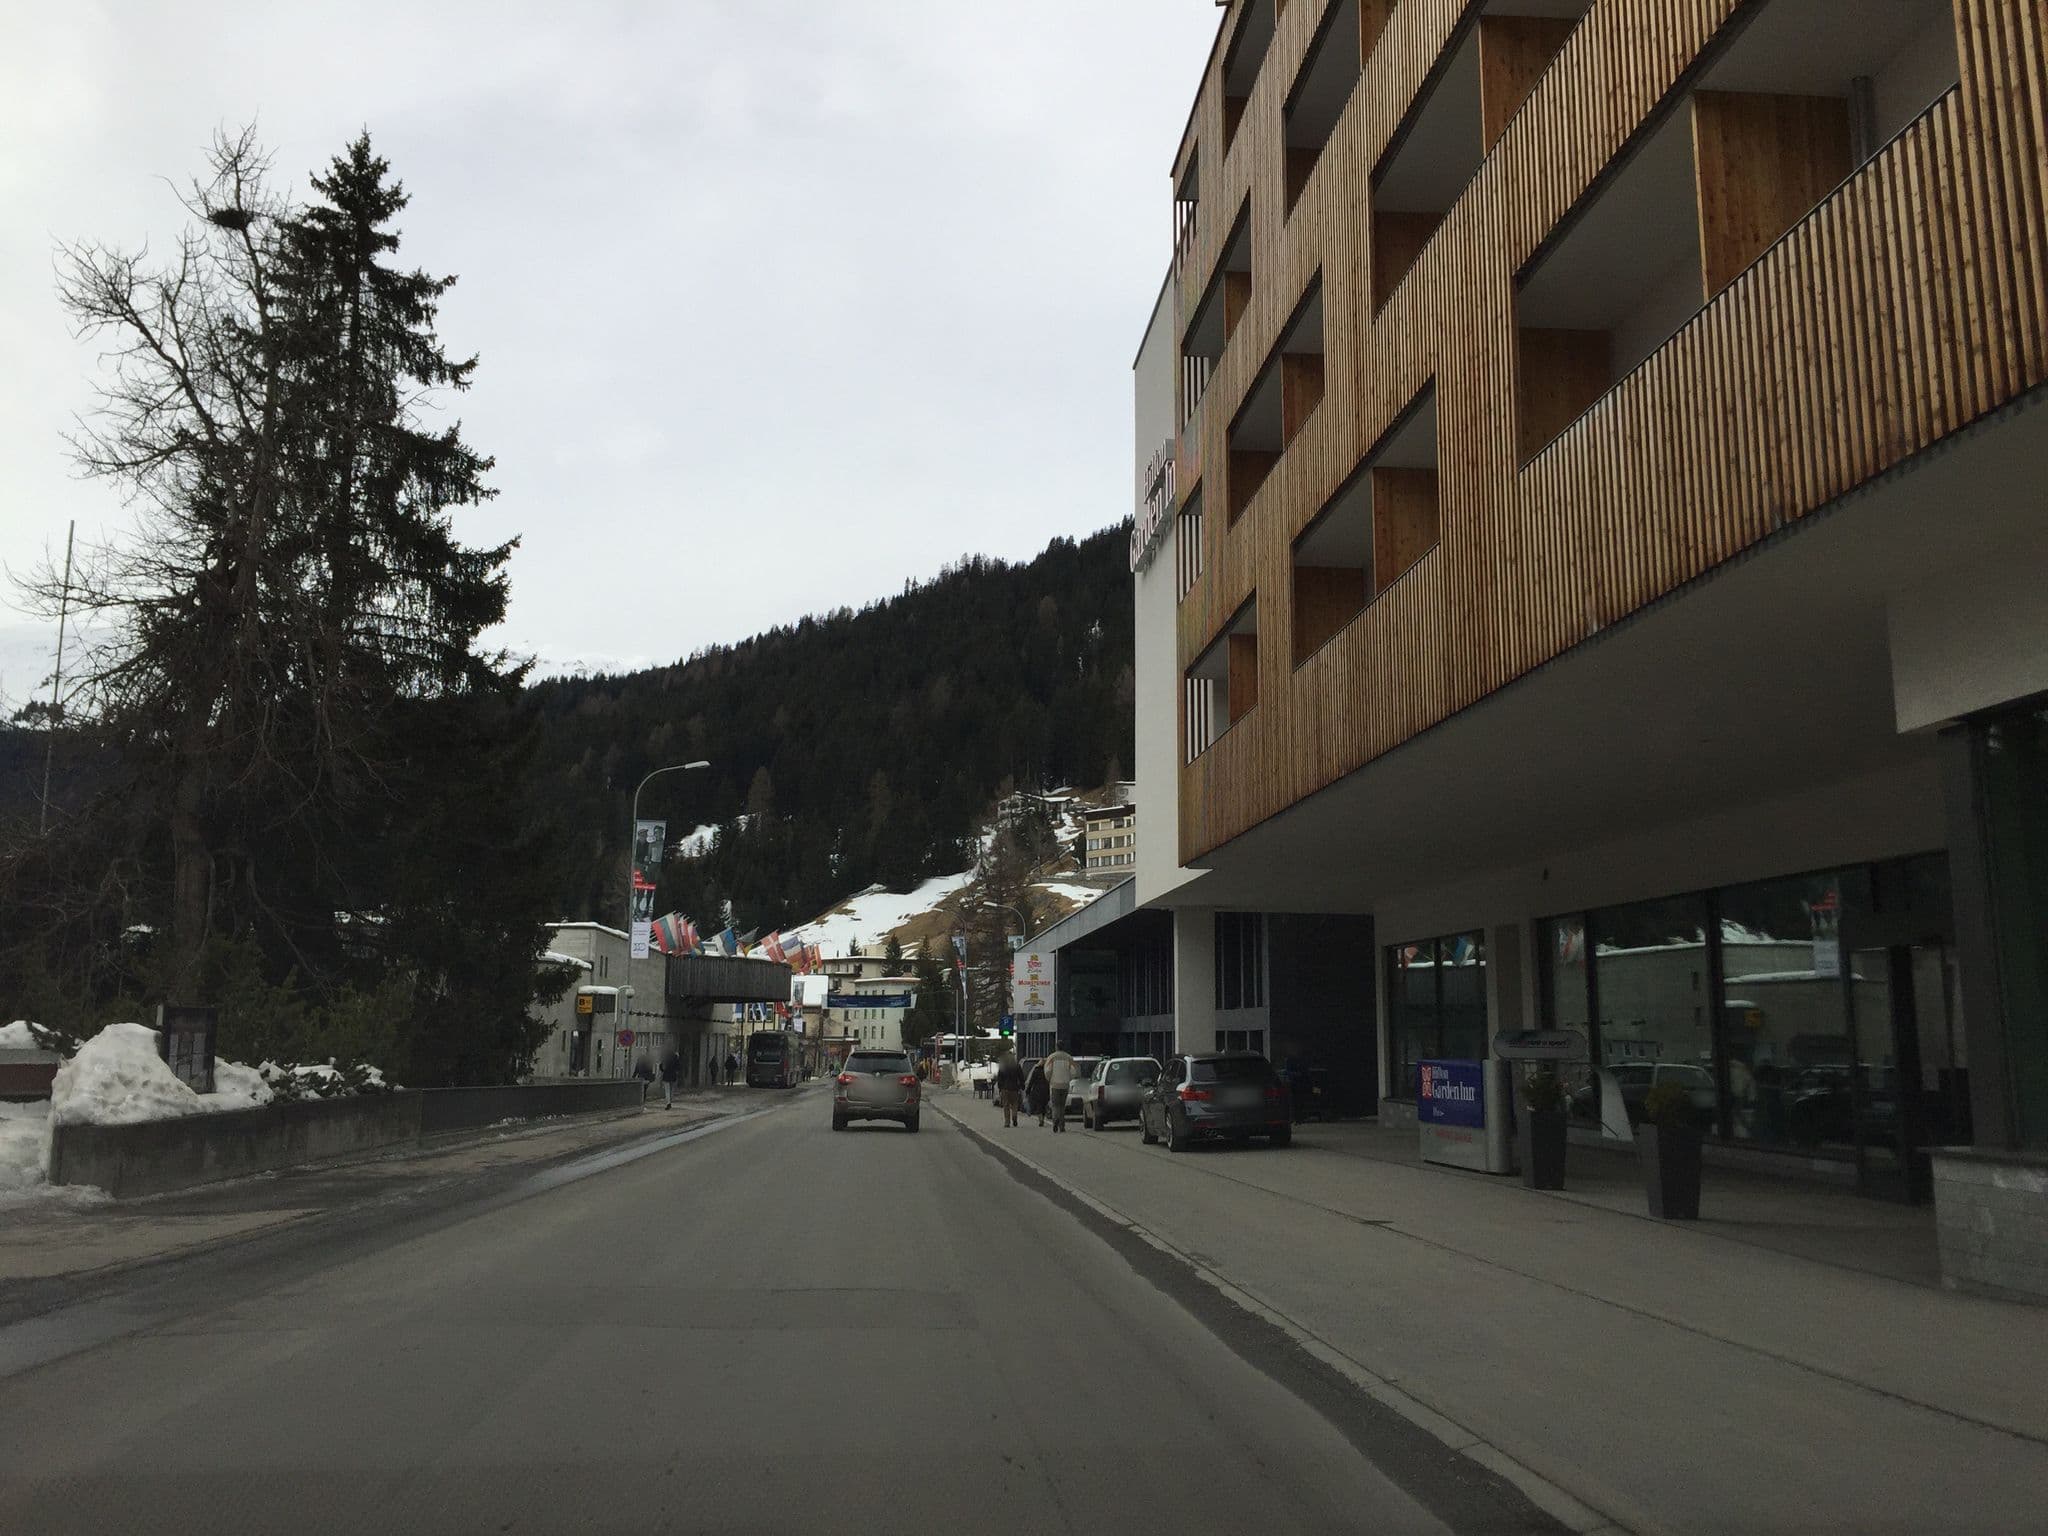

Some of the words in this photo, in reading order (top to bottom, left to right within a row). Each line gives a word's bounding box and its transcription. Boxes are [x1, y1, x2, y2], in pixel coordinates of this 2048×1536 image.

[1129, 487, 1163, 573] Garden
[1432, 1080, 1460, 1100] Garden
[1460, 1081, 1476, 1101] Inn
